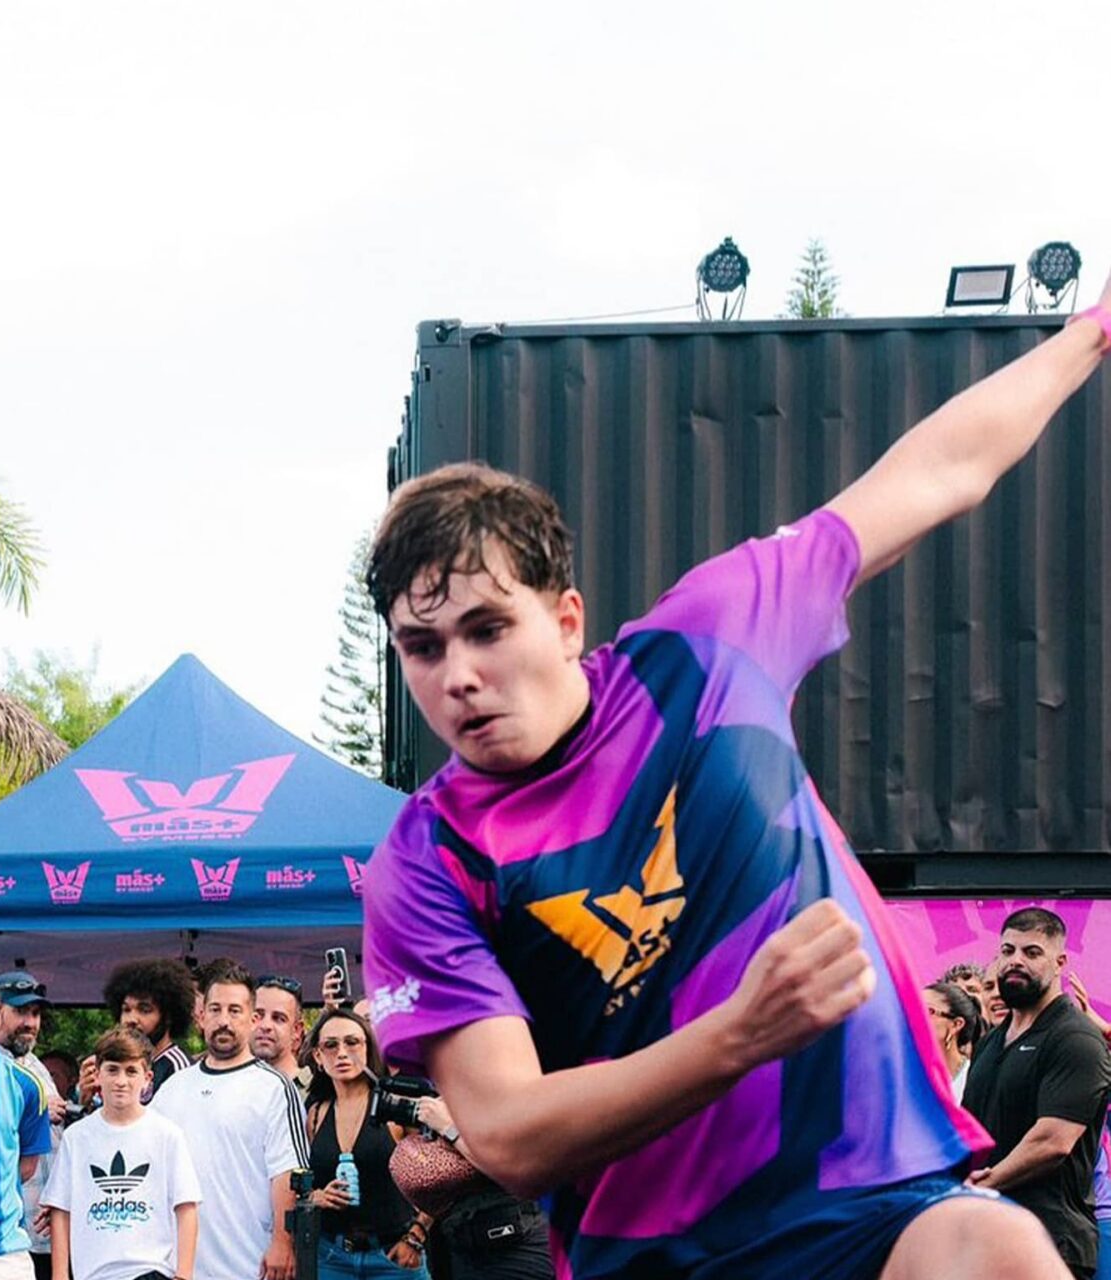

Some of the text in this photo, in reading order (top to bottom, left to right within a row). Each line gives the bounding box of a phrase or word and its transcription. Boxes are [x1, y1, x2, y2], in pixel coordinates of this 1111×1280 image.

[115, 868, 166, 886] más+
[265, 865, 317, 883] más+
[90, 1197, 147, 1214] adidas
